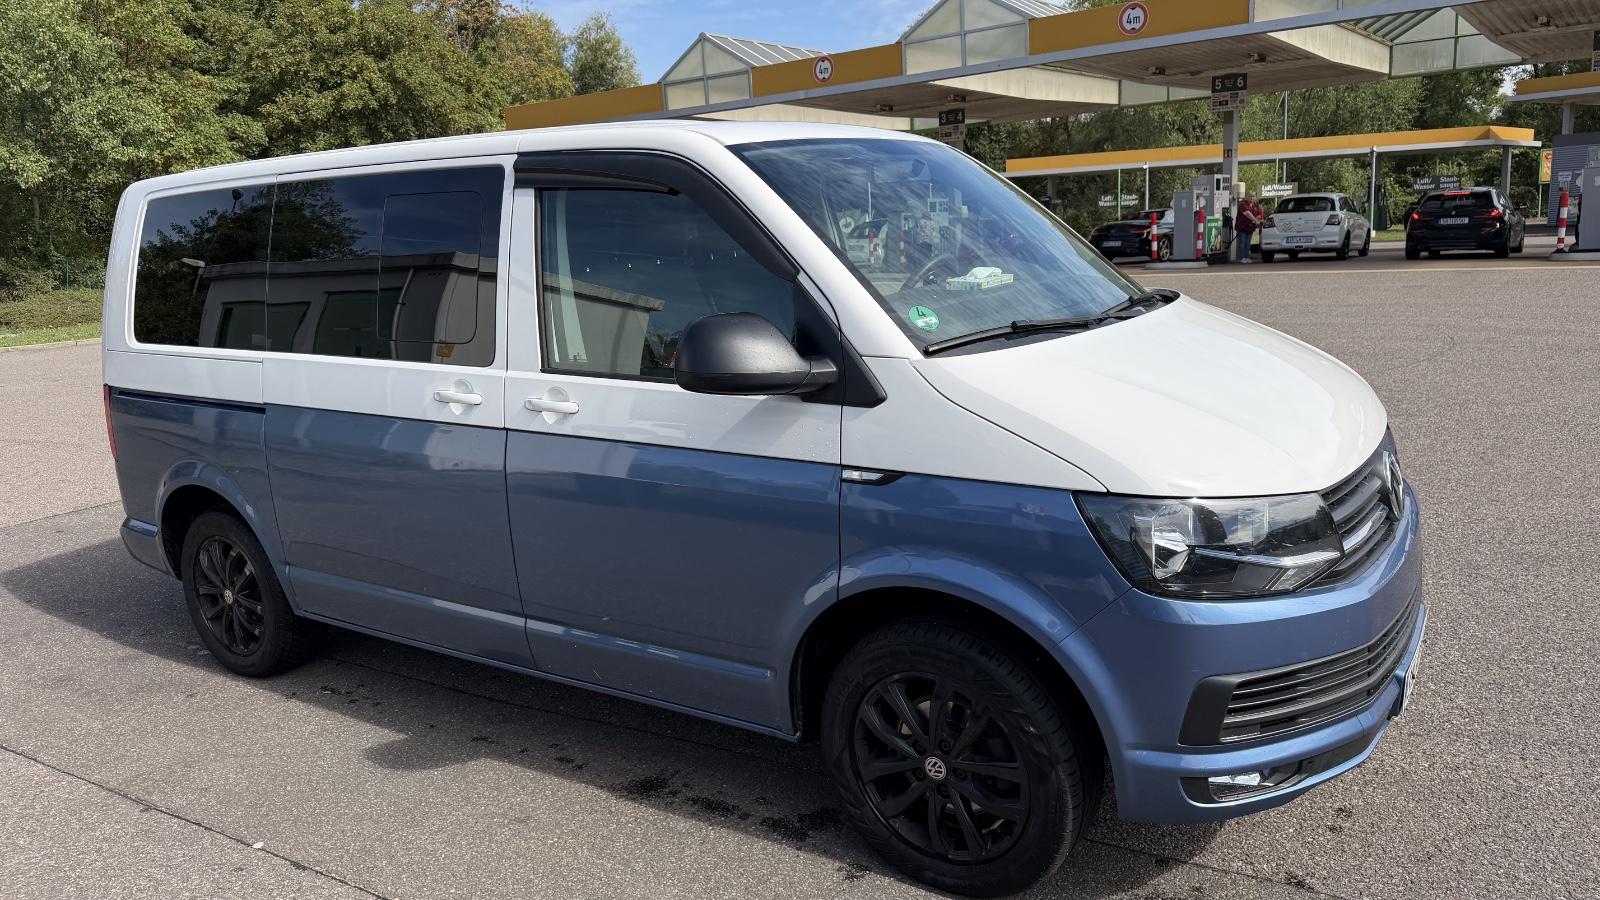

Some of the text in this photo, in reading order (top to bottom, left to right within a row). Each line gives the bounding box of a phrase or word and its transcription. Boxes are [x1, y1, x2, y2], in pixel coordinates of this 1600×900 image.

[1126, 13, 1141, 25] 4m
[819, 65, 829, 75] 4m
[1215, 79, 1222, 90] 5
[1237, 76, 1244, 88] 6
[916, 306, 926, 317] 4
